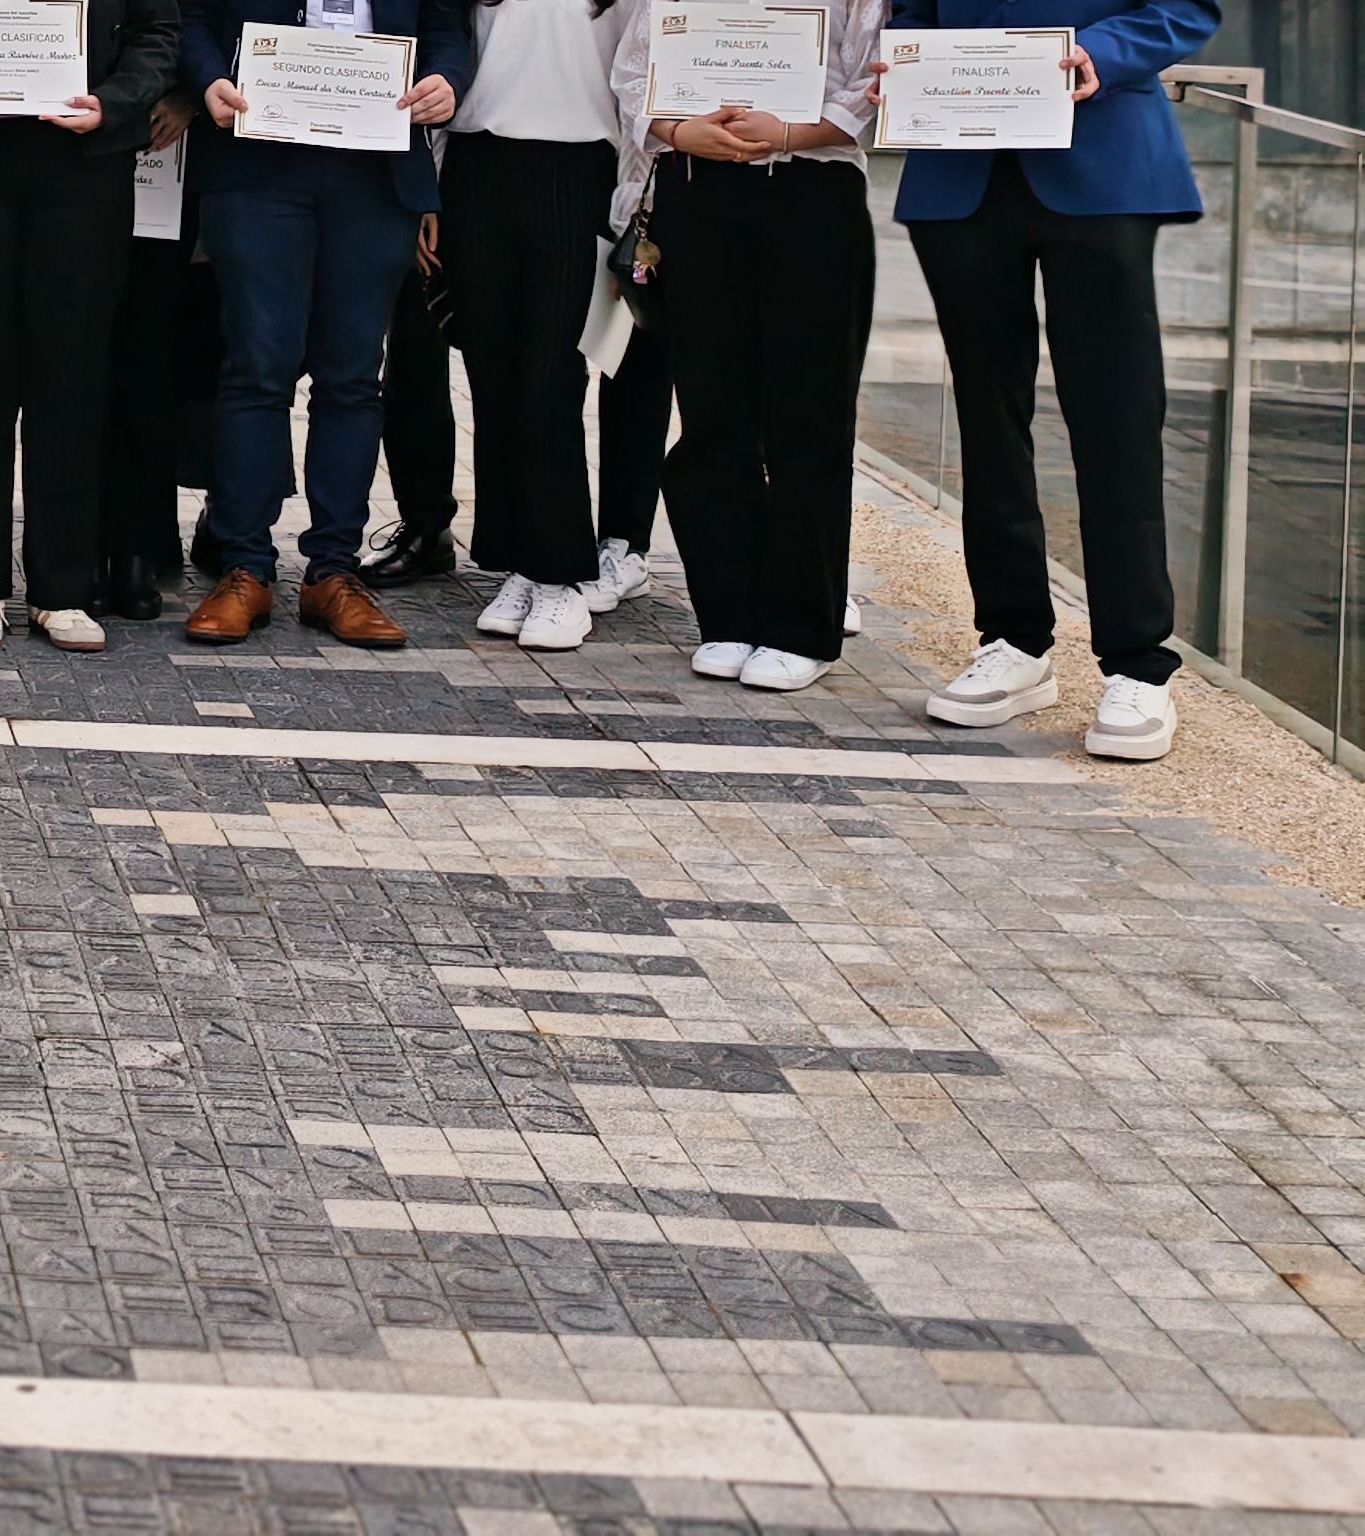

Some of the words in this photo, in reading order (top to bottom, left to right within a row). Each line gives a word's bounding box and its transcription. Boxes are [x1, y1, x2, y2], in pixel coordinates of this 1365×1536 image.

[1, 33, 65, 43] CLASIFICADO
[715, 39, 768, 50] FINALISTA
[730, 58, 763, 69] Puente
[272, 62, 322, 75] SEGUNDO
[324, 67, 390, 81] CLASIFICADO
[952, 67, 1011, 77] FINALISTA
[973, 86, 1012, 96] Puente
